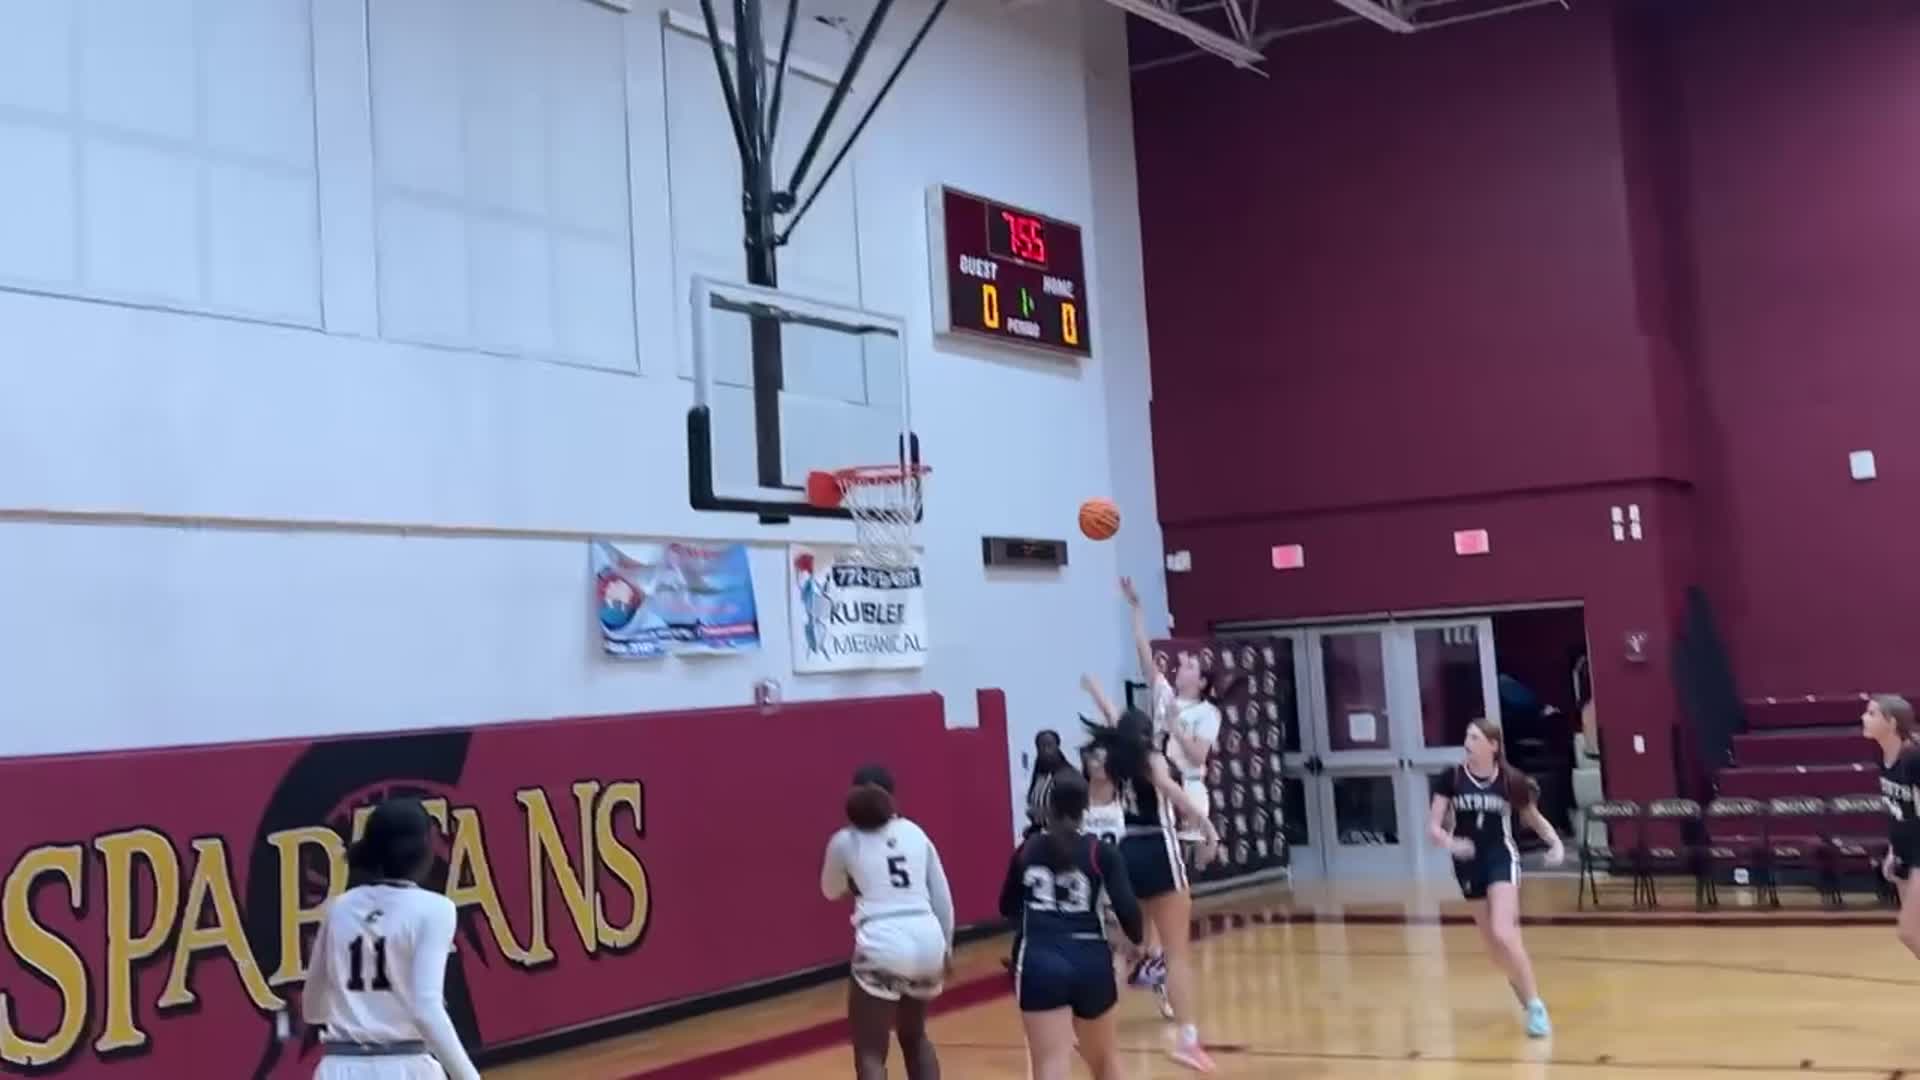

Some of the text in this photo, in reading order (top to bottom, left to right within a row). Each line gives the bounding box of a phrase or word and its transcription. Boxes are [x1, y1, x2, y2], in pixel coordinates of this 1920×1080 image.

[959, 254, 998, 281] GUEST
[982, 283, 1000, 329] 0
[1061, 302, 1079, 345] 0
[886, 855, 911, 889] 5
[346, 935, 392, 992] 11
